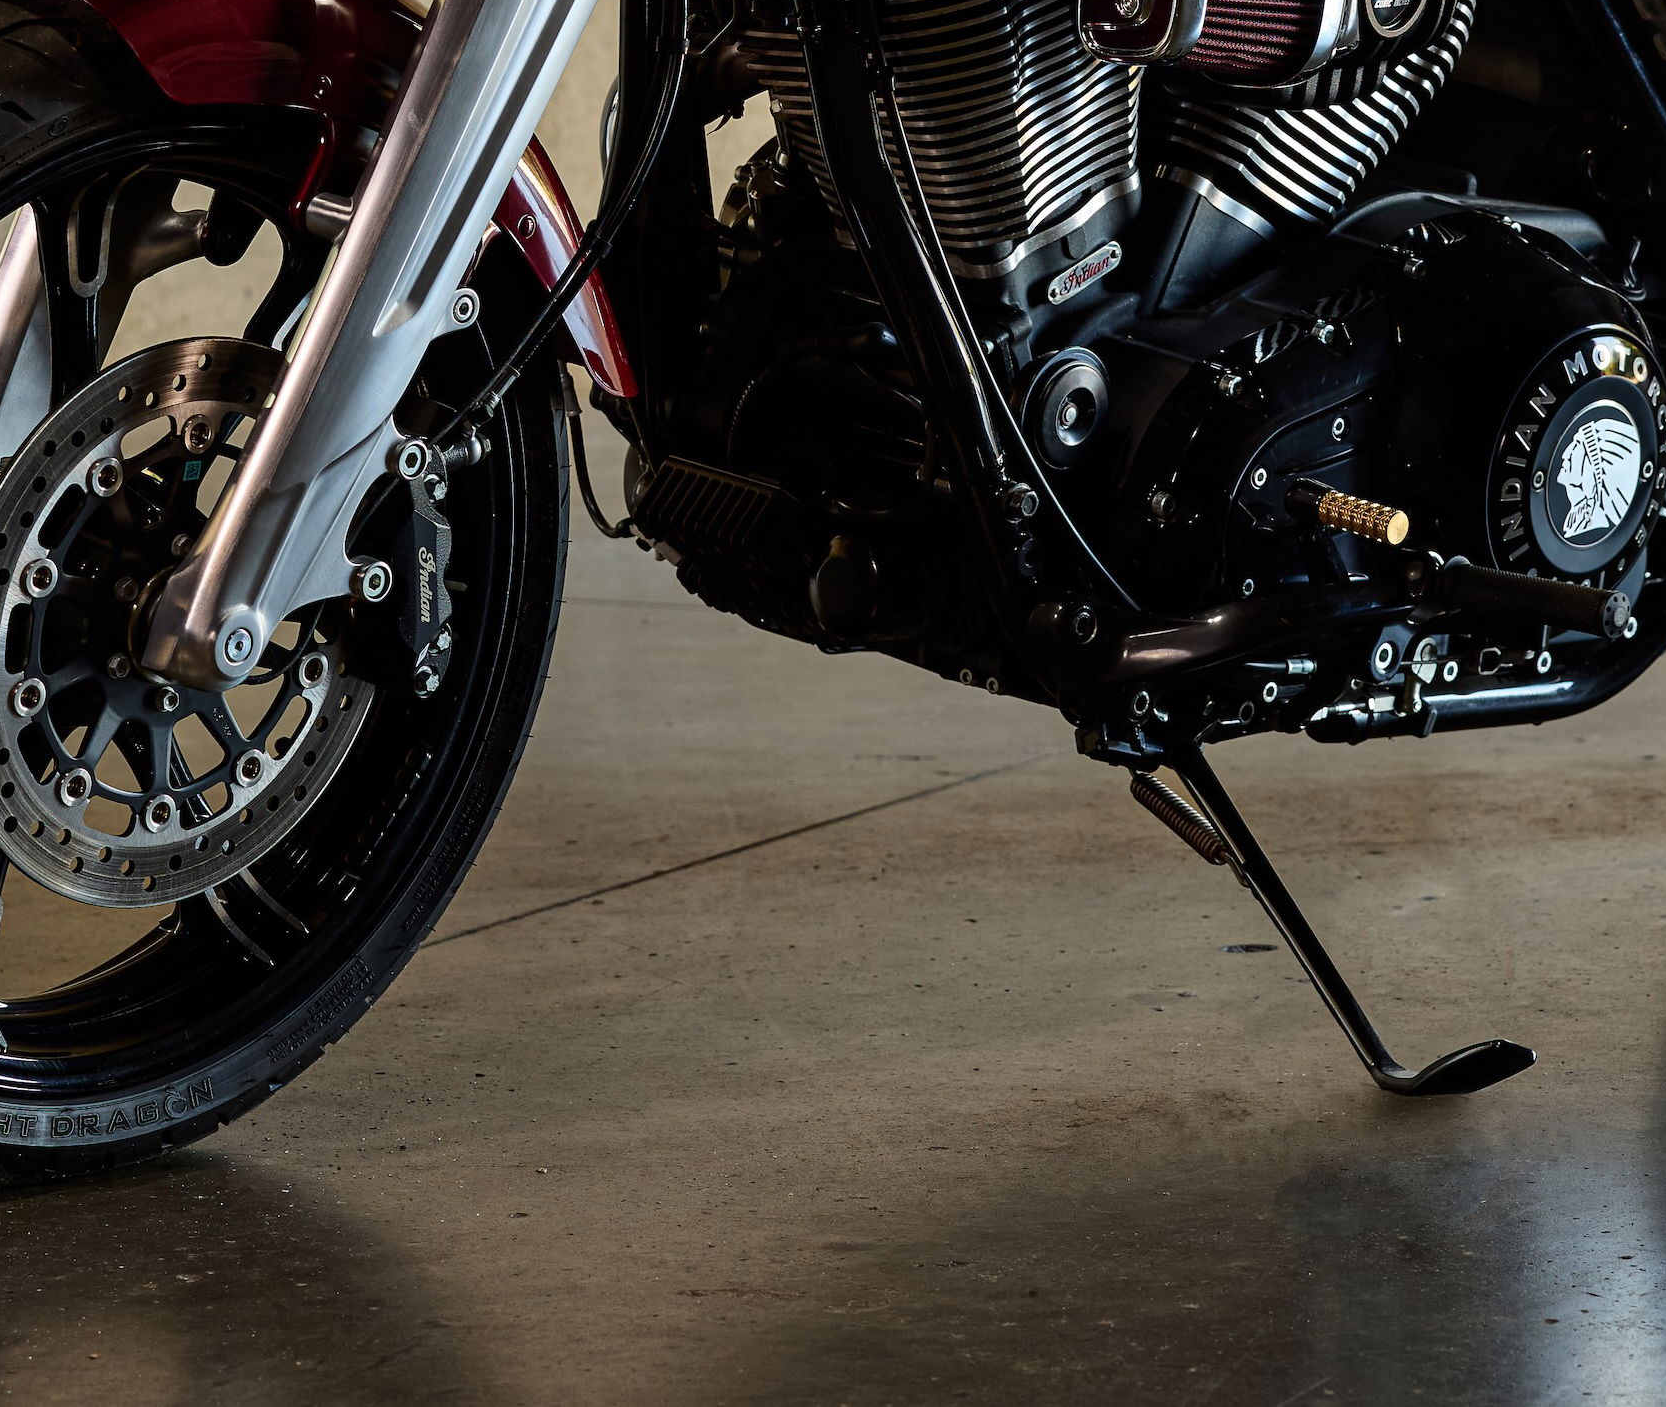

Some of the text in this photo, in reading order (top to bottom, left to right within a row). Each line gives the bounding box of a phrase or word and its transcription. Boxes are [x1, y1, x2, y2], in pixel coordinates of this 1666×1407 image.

[1060, 256, 1110, 296] Indian
[1501, 383, 1557, 562] INDIAN
[418, 546, 437, 623] Indian
[50, 1077, 215, 1138] DRAGON
